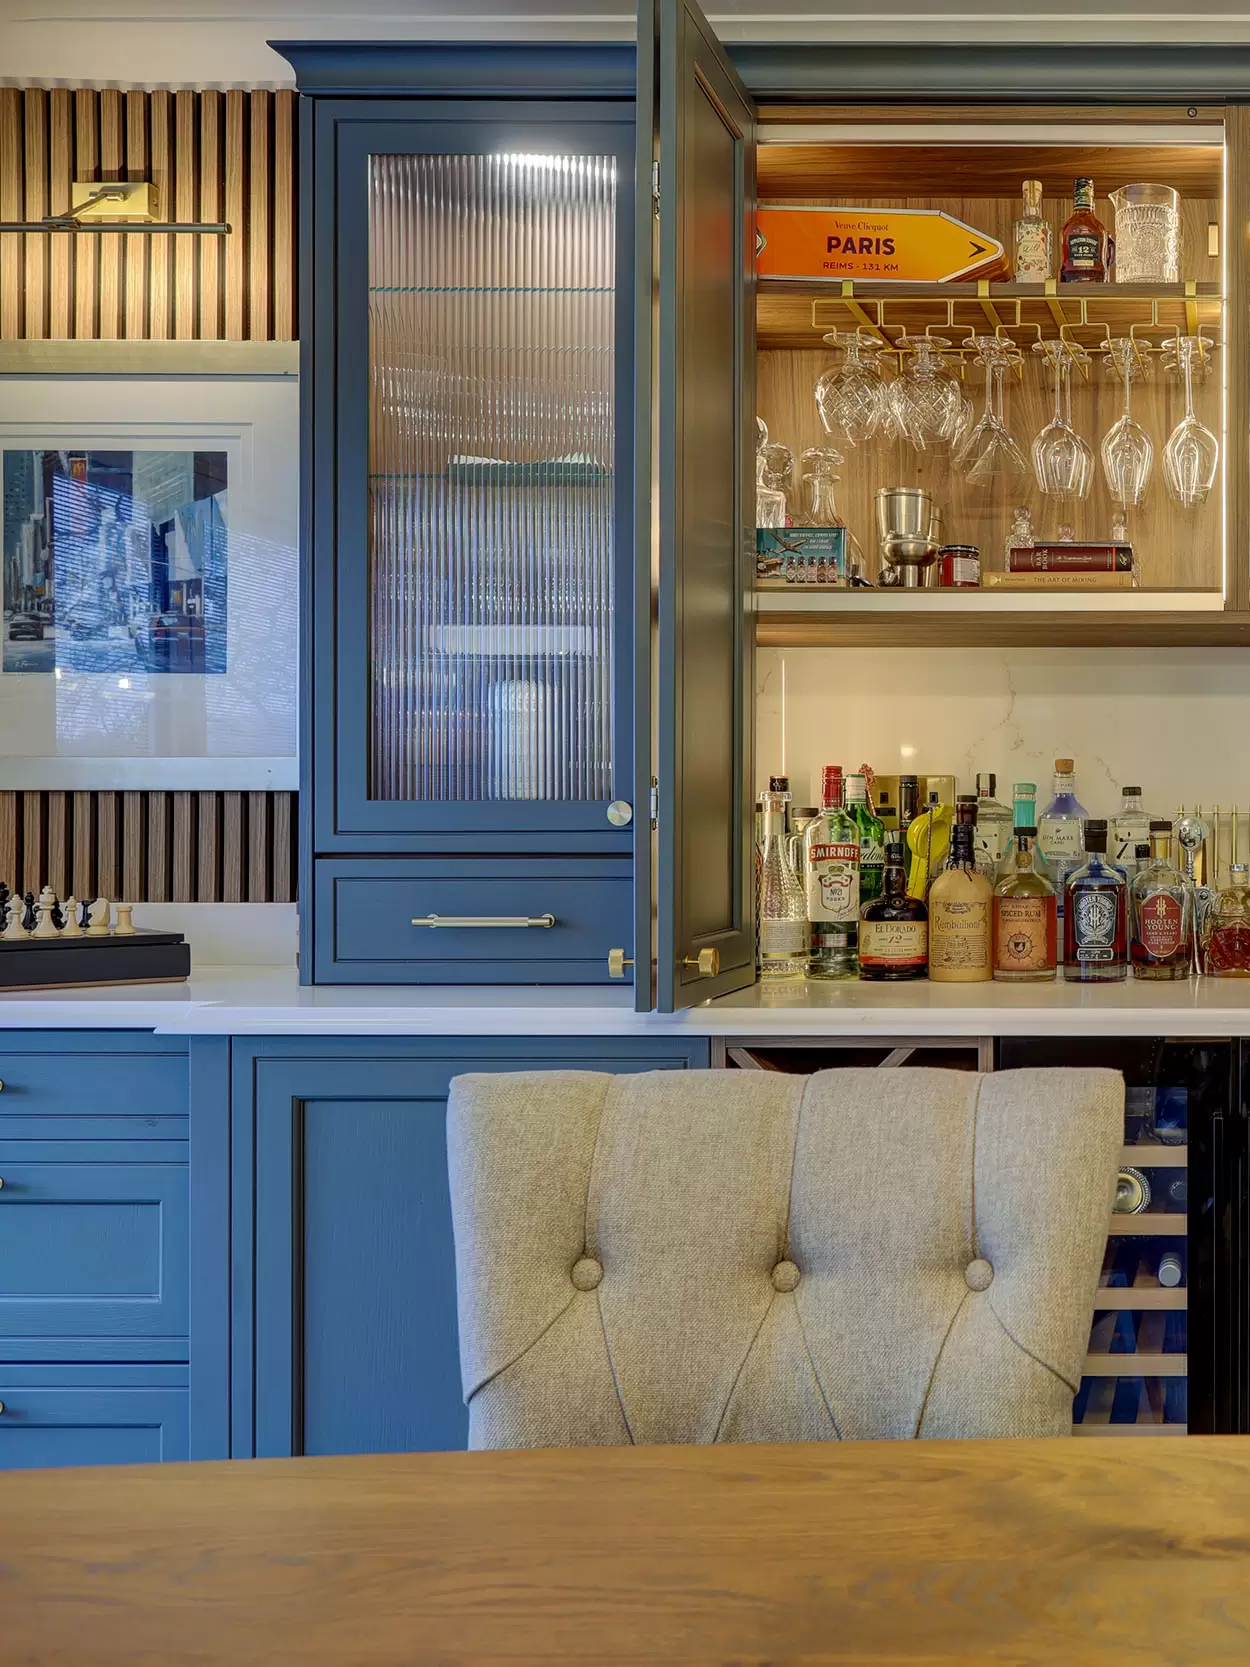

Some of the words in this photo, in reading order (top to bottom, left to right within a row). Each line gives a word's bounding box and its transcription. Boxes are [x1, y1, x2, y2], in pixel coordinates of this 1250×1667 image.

[835, 220, 856, 230] Veuve
[857, 221, 889, 232] Clicquot
[827, 236, 896, 255] PARIS
[1077, 246, 1090, 254] 12
[823, 261, 854, 270] REIMS
[862, 263, 880, 271] 131
[884, 263, 899, 271] KM
[810, 846, 859, 859] SMIRNOFF
[875, 924, 883, 933] EL
[885, 924, 916, 934] DORADO
[888, 934, 903, 944] 12
